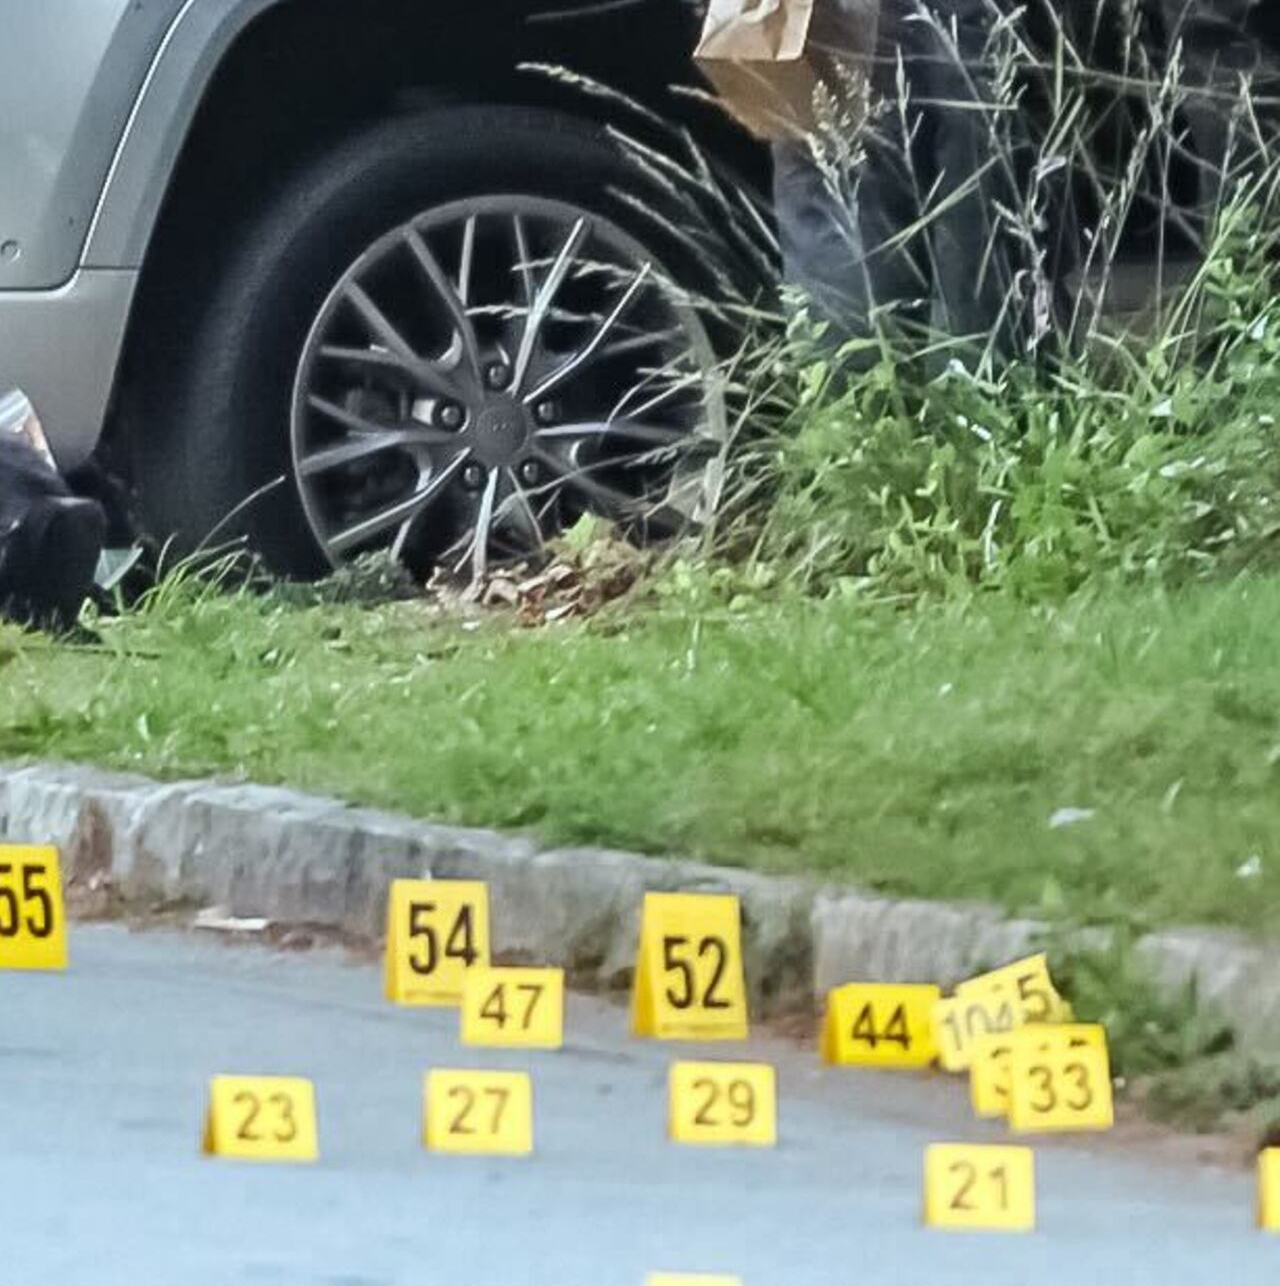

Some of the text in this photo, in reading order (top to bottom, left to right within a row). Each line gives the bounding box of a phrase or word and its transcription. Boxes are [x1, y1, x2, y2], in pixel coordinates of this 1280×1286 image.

[407, 902, 478, 976] 54
[662, 935, 731, 1010] 52
[479, 983, 545, 1031] 47
[850, 1002, 913, 1051] 44
[447, 1086, 511, 1136] 27
[691, 1078, 756, 1128] 29
[1028, 1062, 1093, 1114] 33
[231, 1091, 298, 1144] 23
[948, 1160, 1010, 1213] 21
